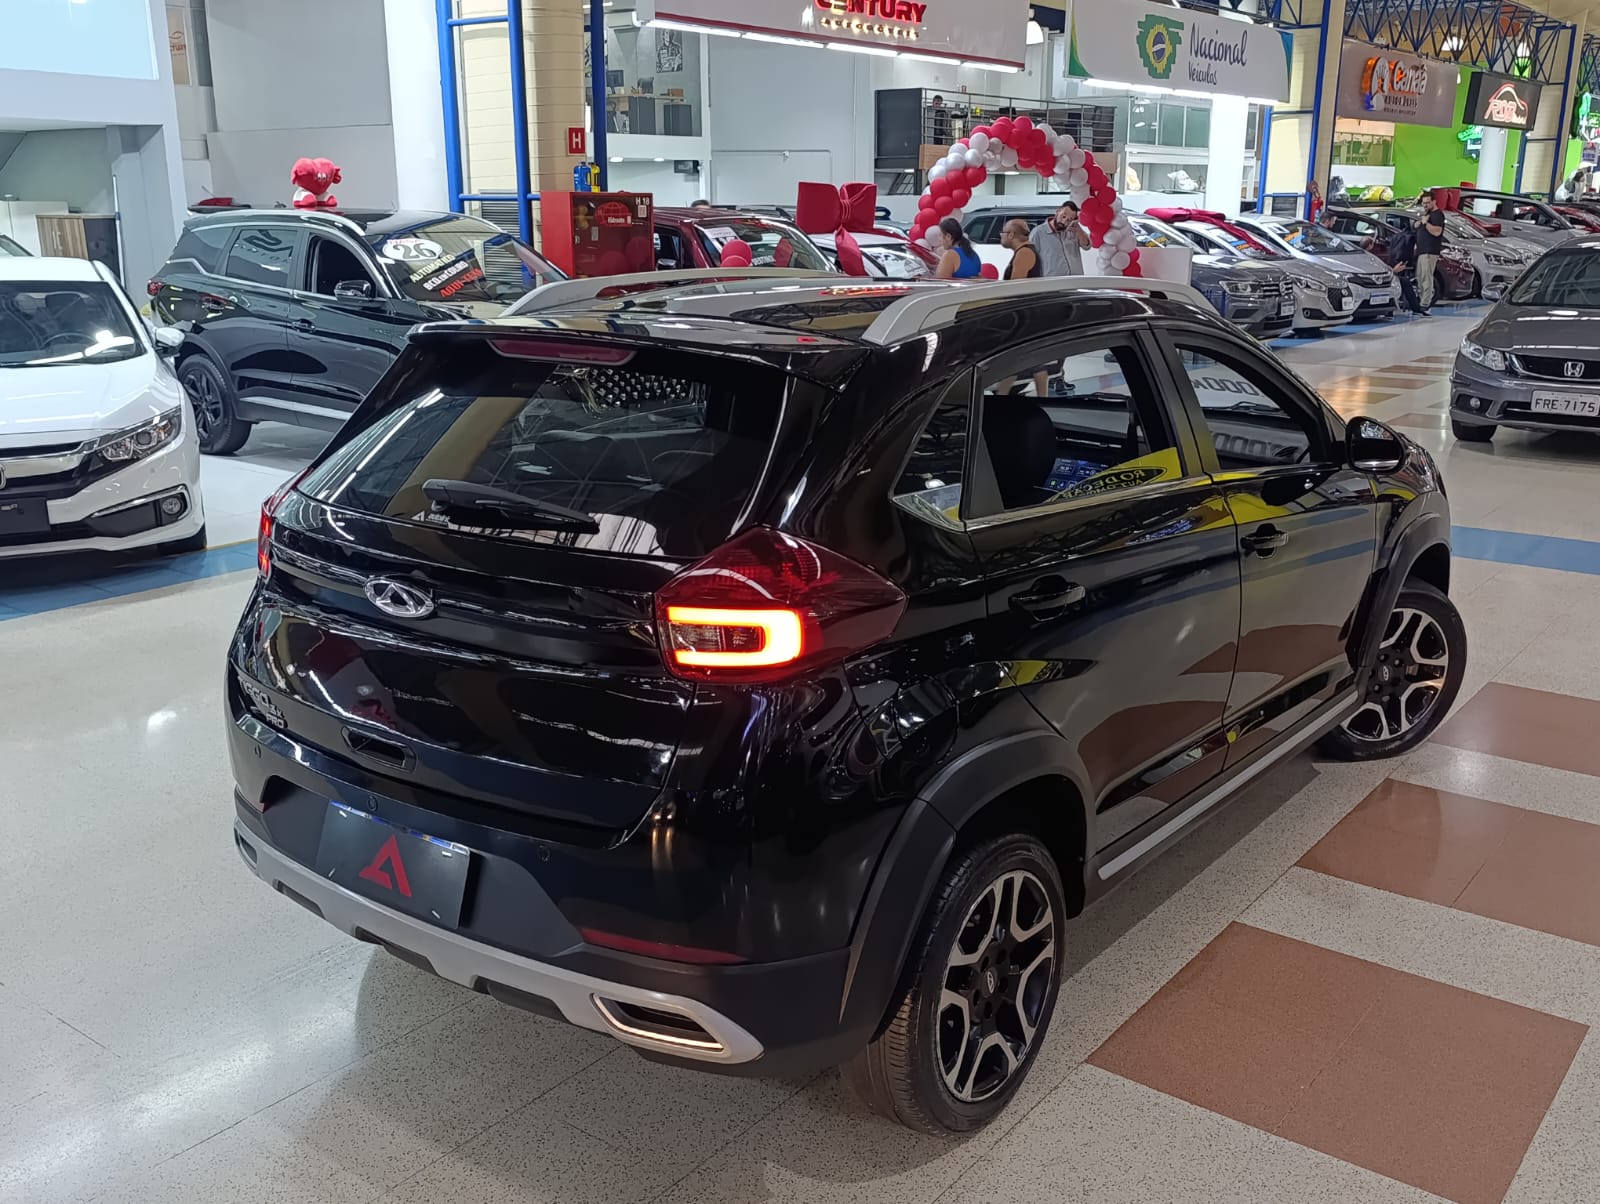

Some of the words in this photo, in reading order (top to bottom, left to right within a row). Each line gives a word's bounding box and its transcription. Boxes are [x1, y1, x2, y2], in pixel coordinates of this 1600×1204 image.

[1190, 22, 1247, 66] Nacional
[571, 131, 583, 149] H
[635, 197, 642, 206] H
[392, 243, 437, 260] 26
[266, 713, 287, 729] PRO
